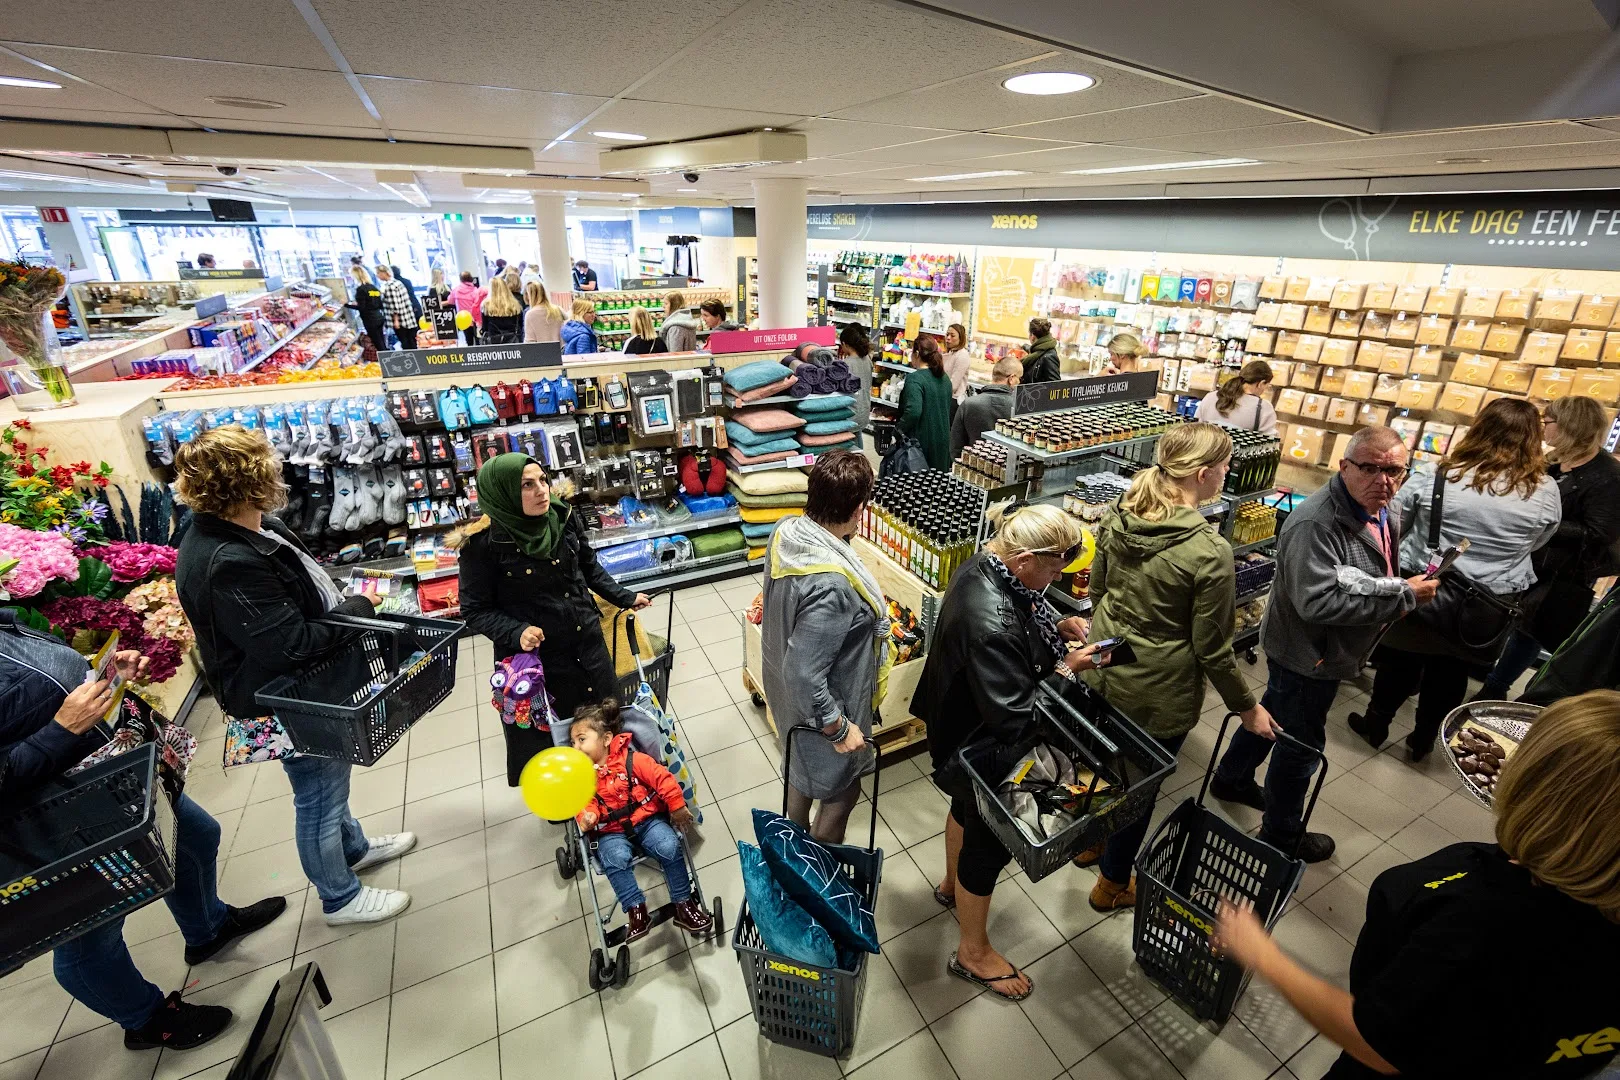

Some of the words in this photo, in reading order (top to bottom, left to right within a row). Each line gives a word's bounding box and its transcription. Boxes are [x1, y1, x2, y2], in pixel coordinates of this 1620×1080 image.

[807, 213, 831, 225] ERELDSE
[991, 214, 1038, 230] xenos
[1408, 210, 1464, 233] ELKE
[1470, 209, 1524, 235] DAG
[1531, 209, 1581, 236] EEN
[753, 335, 763, 344] UIT
[763, 334, 777, 343] ONZE
[777, 333, 797, 342] FOLDER
[426, 354, 448, 365] VOOR
[450, 353, 465, 364] ELK
[466, 350, 522, 363] REISAVONTUUR
[1049, 389, 1061, 400] UIT
[1062, 387, 1070, 399] DE
[1071, 383, 1106, 398] ITALIAANSE
[1107, 380, 1129, 393] KEUKEN
[1164, 895, 1214, 936] xenos
[768, 959, 820, 981] xenos
